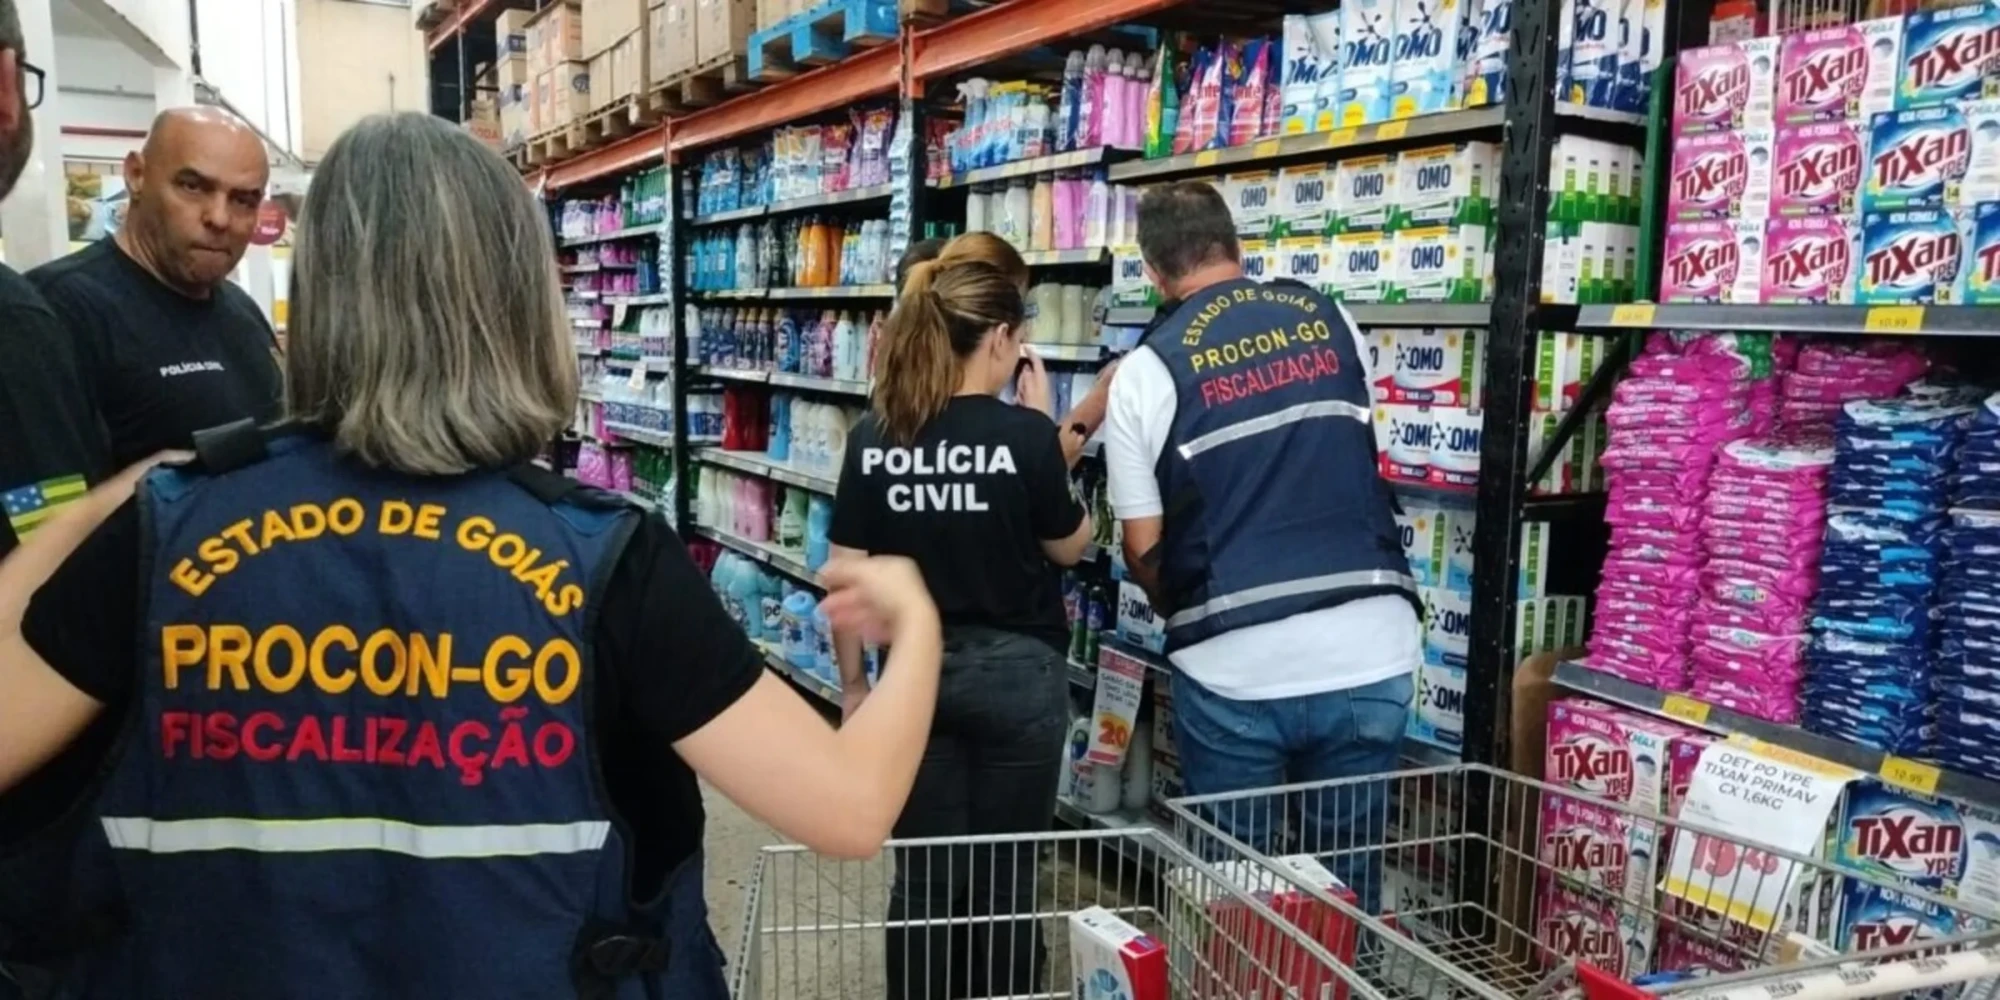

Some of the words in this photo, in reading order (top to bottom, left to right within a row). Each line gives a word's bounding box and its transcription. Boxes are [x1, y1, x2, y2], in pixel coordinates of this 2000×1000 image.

[1295, 180, 1324, 204] OMO
[1353, 173, 1384, 198] OMO
[1417, 164, 1451, 191] OMO
[1241, 186, 1268, 208] OMO
[1291, 253, 1319, 275] OMO
[1348, 250, 1379, 272] OMO
[1411, 244, 1444, 270] OMO
[1182, 295, 1231, 346] ESTADO
[1233, 288, 1257, 303] DE
[1262, 290, 1318, 313] GOIÁS
[1190, 319, 1330, 374] PROCON-GO
[1408, 346, 1444, 370] OMO
[1201, 344, 1340, 409] FISCALIZAÇÃO
[1451, 426, 1479, 452] OM
[861, 438, 1018, 477] POLÍCIA
[886, 483, 990, 514] CIVIL
[168, 496, 365, 598] ESTADO
[377, 498, 447, 540] DE
[455, 514, 584, 618] GOIÁS
[160, 623, 581, 705] PROCON-GO
[160, 706, 576, 787] FISCALIZAÇÃO
[1098, 720, 1128, 749] 20
[1552, 743, 1629, 781] TiXan
[1719, 752, 1752, 770] DET
[1754, 763, 1777, 776] PO
[1782, 771, 1813, 788] YPE
[1704, 761, 1750, 784] TIXAN
[1750, 775, 1819, 805] PRIMAV
[1719, 782, 1739, 796] CX
[1852, 815, 1962, 859] TiXan
